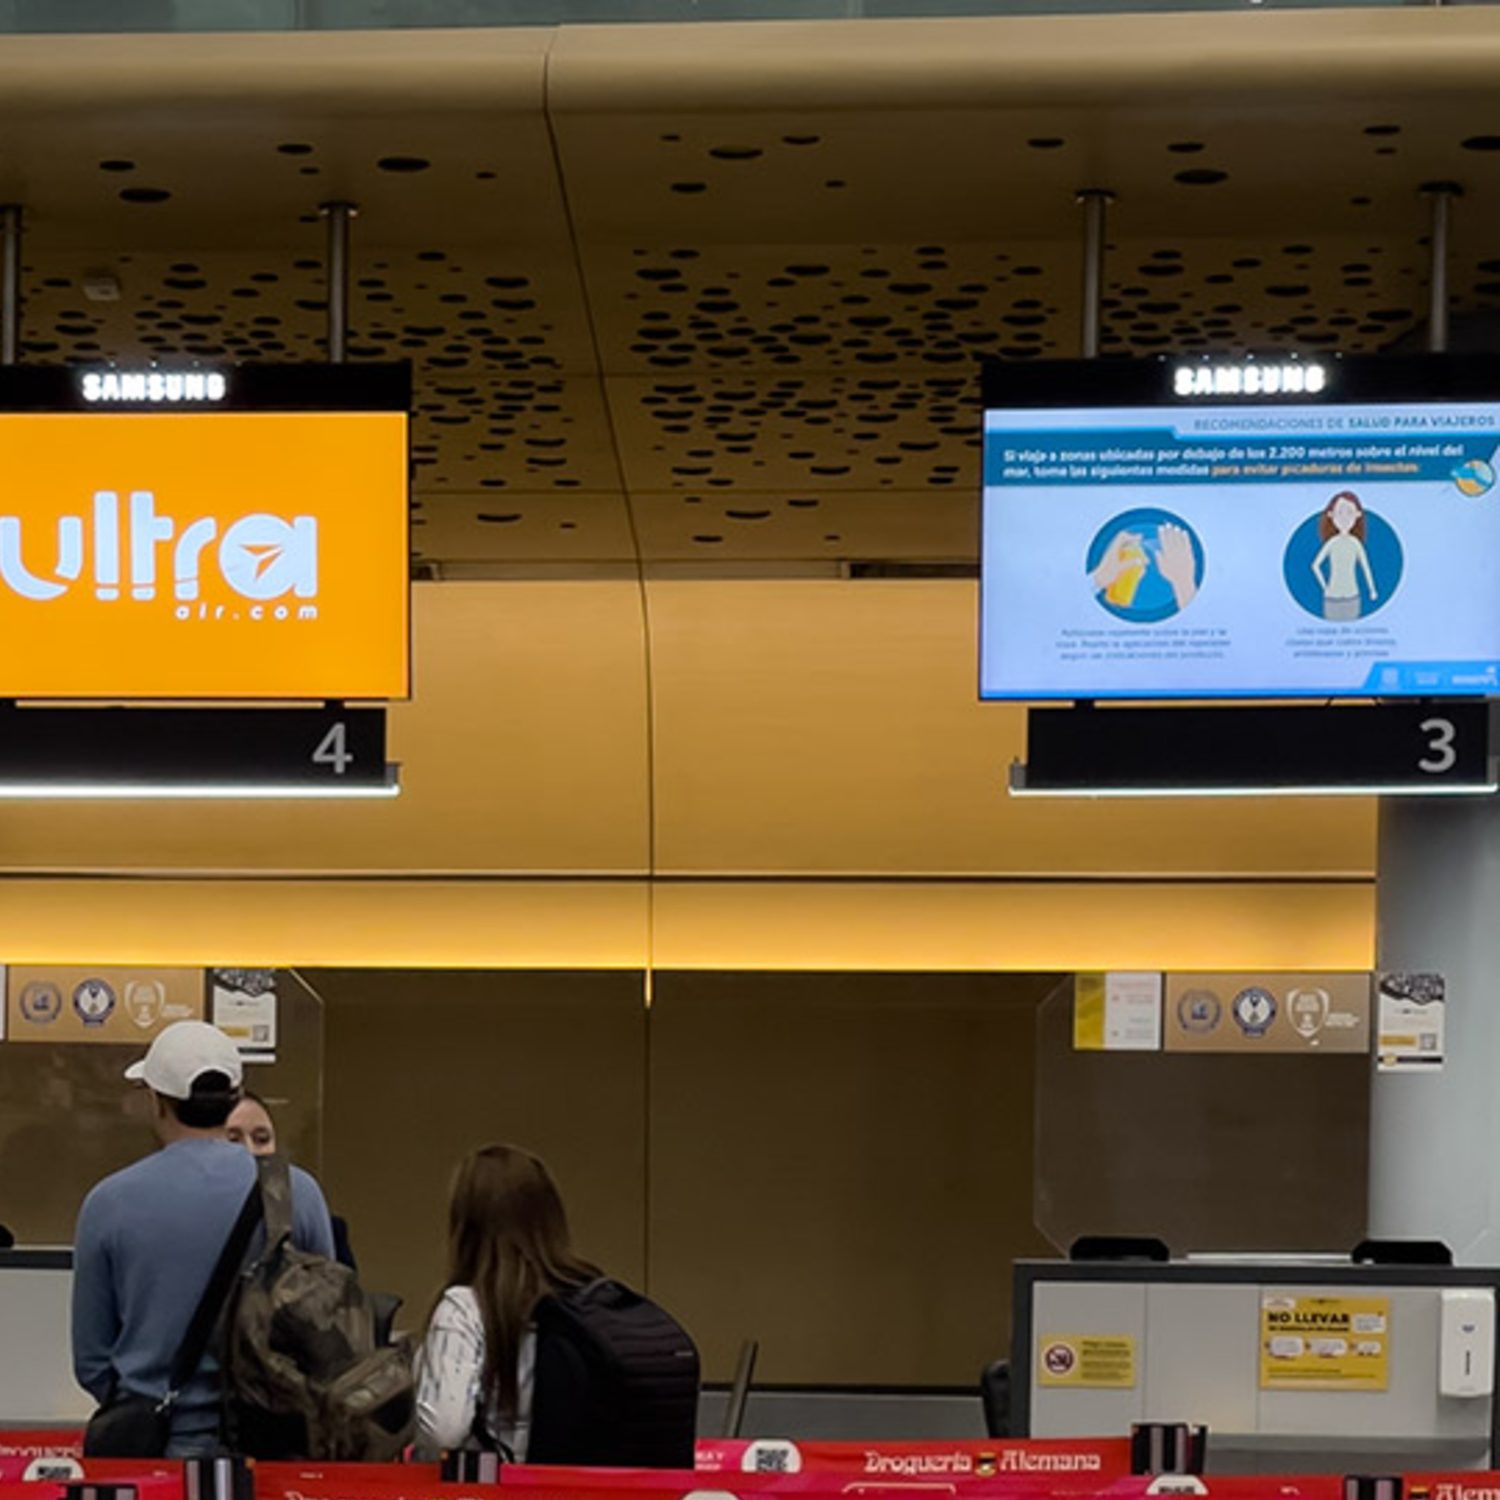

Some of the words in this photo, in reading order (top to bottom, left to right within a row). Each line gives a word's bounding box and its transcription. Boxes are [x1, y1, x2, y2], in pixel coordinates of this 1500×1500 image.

[82, 373, 226, 402] SAMSUNG
[1174, 365, 1326, 396] SAMSUNG
[1348, 417, 1390, 429] SALUD
[1394, 416, 1428, 428] PARA
[1430, 415, 1495, 428] VIAJEROS
[1100, 448, 1155, 462] ubicadas
[1157, 448, 1180, 463] por
[1211, 465, 1240, 478] para
[175, 602, 319, 621] air.com
[312, 722, 354, 774] 4
[1417, 718, 1457, 773] 3
[1267, 1312, 1292, 1324] NO
[1293, 1312, 1350, 1324] LLEVAR
[1000, 1449, 1101, 1472] Alemana
